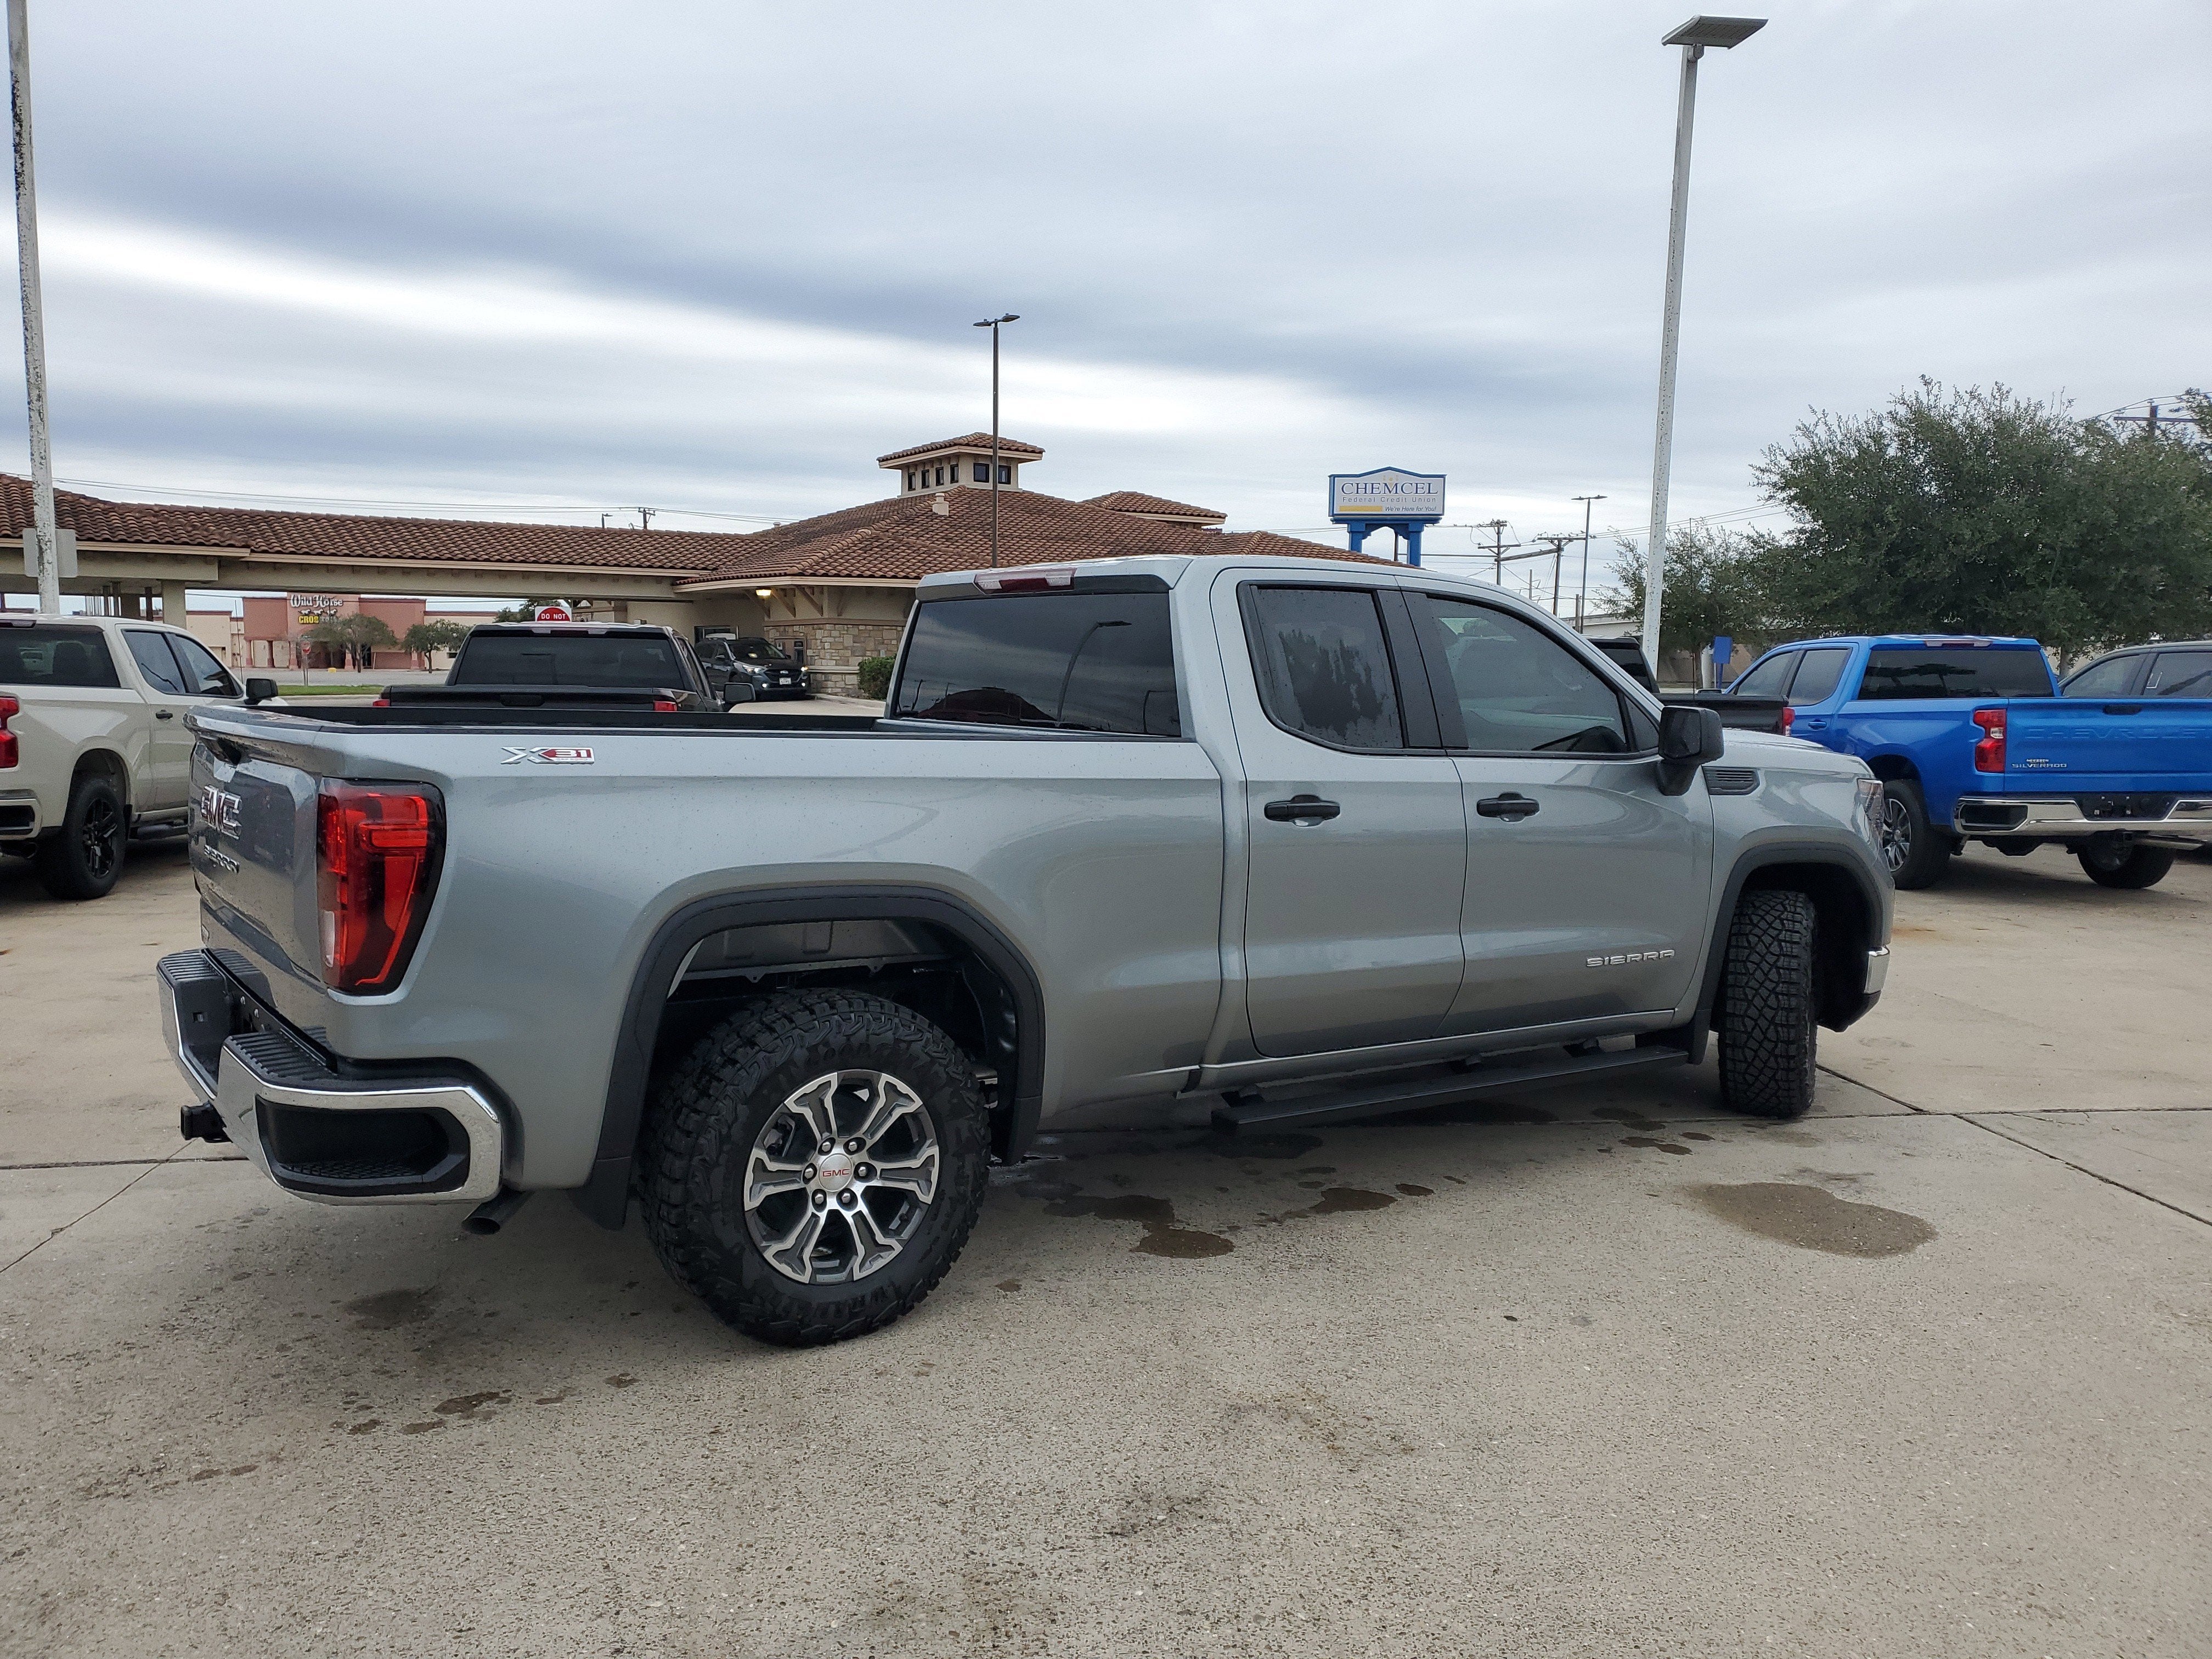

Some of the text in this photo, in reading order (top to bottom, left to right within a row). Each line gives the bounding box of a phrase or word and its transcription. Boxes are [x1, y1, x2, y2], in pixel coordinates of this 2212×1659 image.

[1341, 482, 1438, 495] CHEMCEL
[290, 594, 343, 608] Wild Horse
[201, 785, 242, 840] GMC
[1586, 949, 1675, 967] SIERRA
[822, 1168, 850, 1177] GMC
